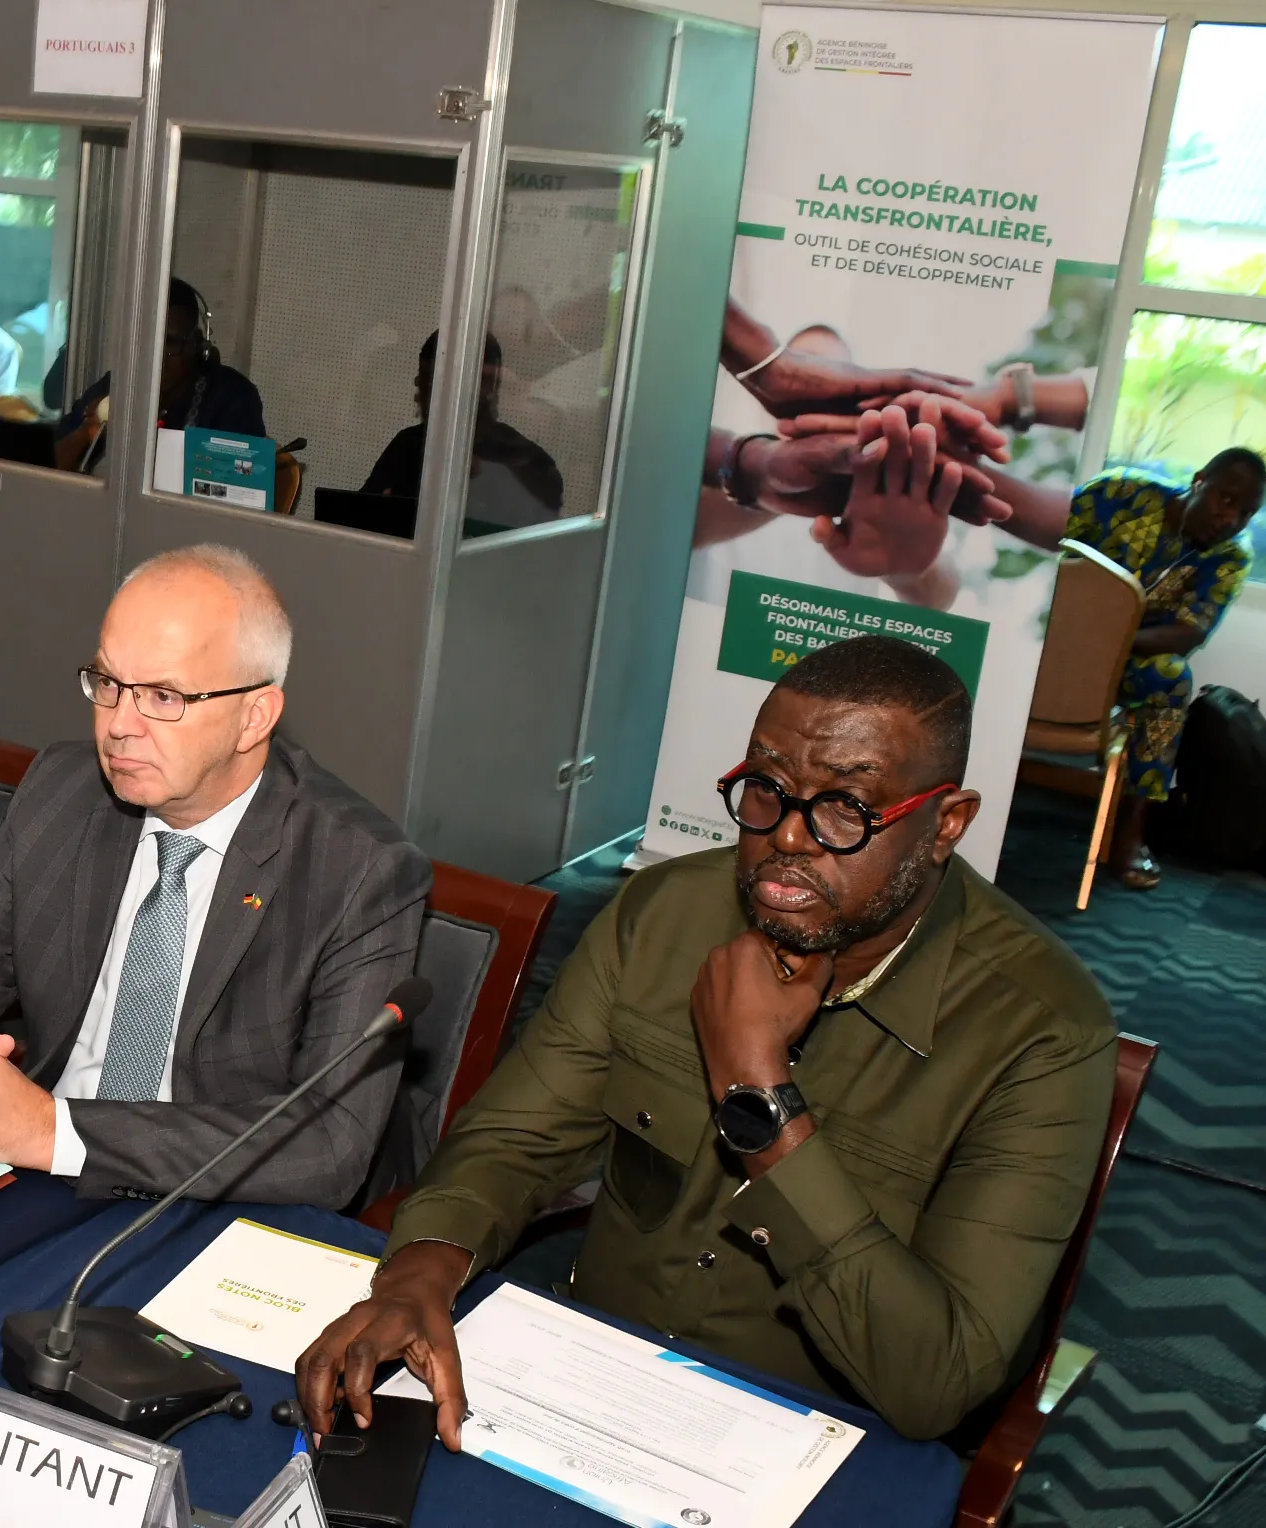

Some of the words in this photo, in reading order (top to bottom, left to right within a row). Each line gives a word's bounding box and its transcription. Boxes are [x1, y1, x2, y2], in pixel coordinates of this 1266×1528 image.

[45, 39, 126, 53] PORTUGUAIS
[128, 42, 135, 54] 3
[817, 39, 846, 47] AGENCE
[848, 39, 888, 49] BÉNINOISE
[827, 48, 859, 57] GESTION
[860, 49, 896, 59] INTÉGRÉE
[830, 57, 862, 66] ESPACES
[863, 59, 913, 69] FRONTALIERS
[818, 173, 848, 193] LA
[856, 177, 1038, 212] COOPÉRATION
[795, 199, 1053, 248] TRANSFRONTALIÈRE,
[794, 233, 842, 250] OUTIL
[847, 238, 870, 253] DE
[875, 242, 965, 264] COHÉSION
[969, 252, 1044, 274] SOCIALE
[811, 254, 831, 267] ET
[835, 257, 857, 271] DE
[862, 259, 1015, 291] DÉVELOPPEMENT
[759, 592, 851, 625] DÉSORMAIS,
[854, 612, 882, 628] LES
[884, 619, 953, 644] ESPACES
[774, 629, 804, 646] DES
[216, 1283, 262, 1301] NOTES
[263, 1298, 302, 1313] BLOC
[286, 1298, 307, 1307] DES
